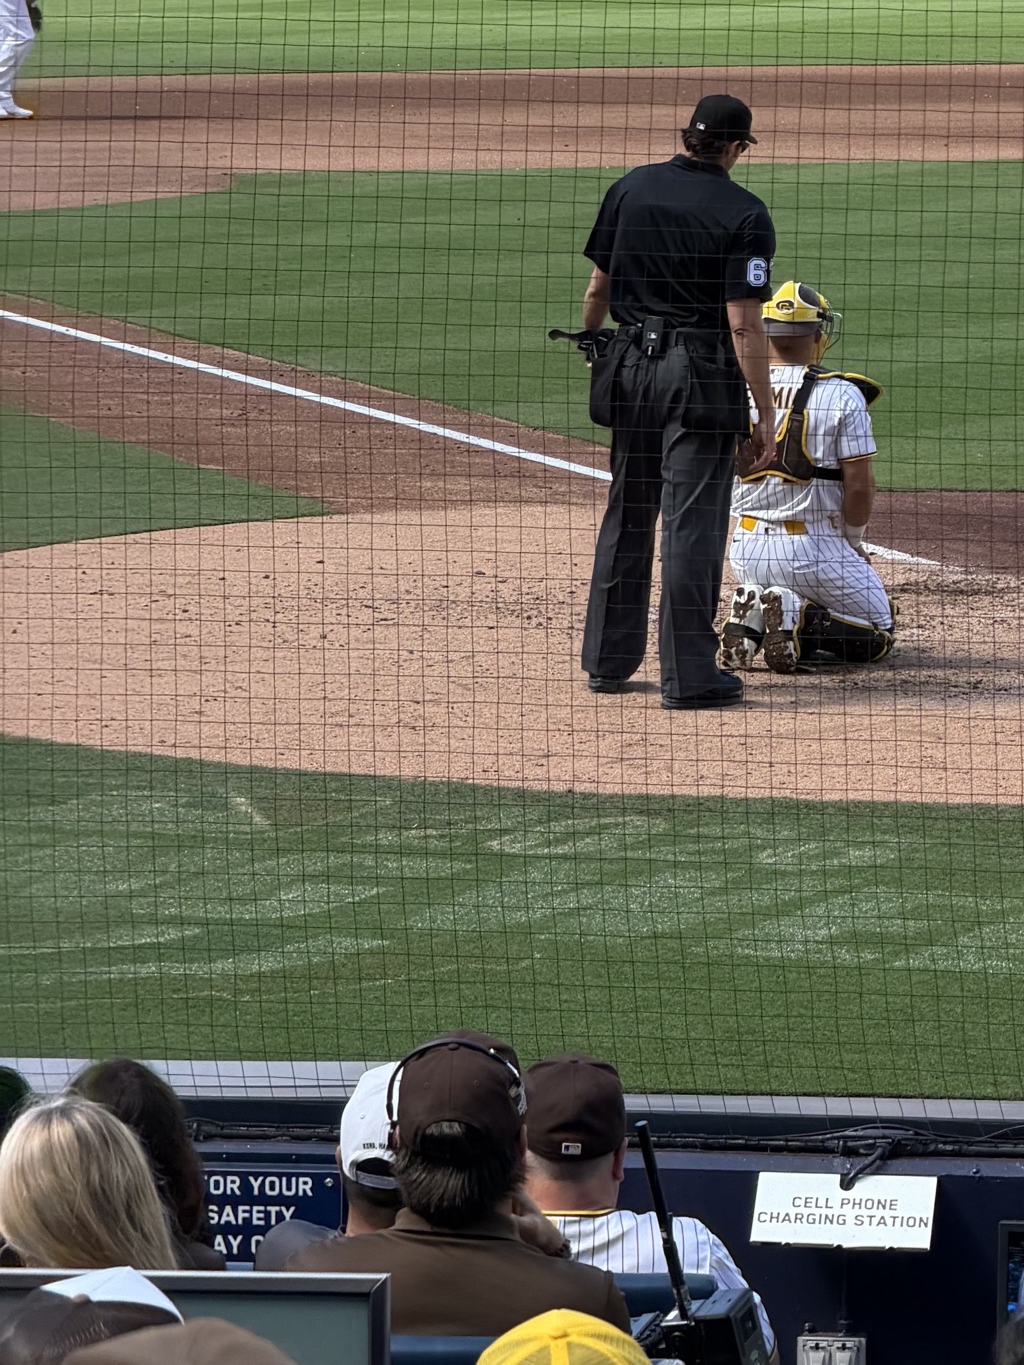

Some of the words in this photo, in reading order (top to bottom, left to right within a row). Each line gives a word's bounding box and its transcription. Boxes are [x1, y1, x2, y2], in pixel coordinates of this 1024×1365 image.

[205, 1175, 241, 1195] OR
[249, 1176, 313, 1196] YOUR
[792, 1196, 833, 1209] CELL
[840, 1198, 898, 1211] PHONE
[208, 1205, 296, 1225] SAFETY
[757, 1212, 847, 1226] CHARGING
[854, 1215, 929, 1228] STATION
